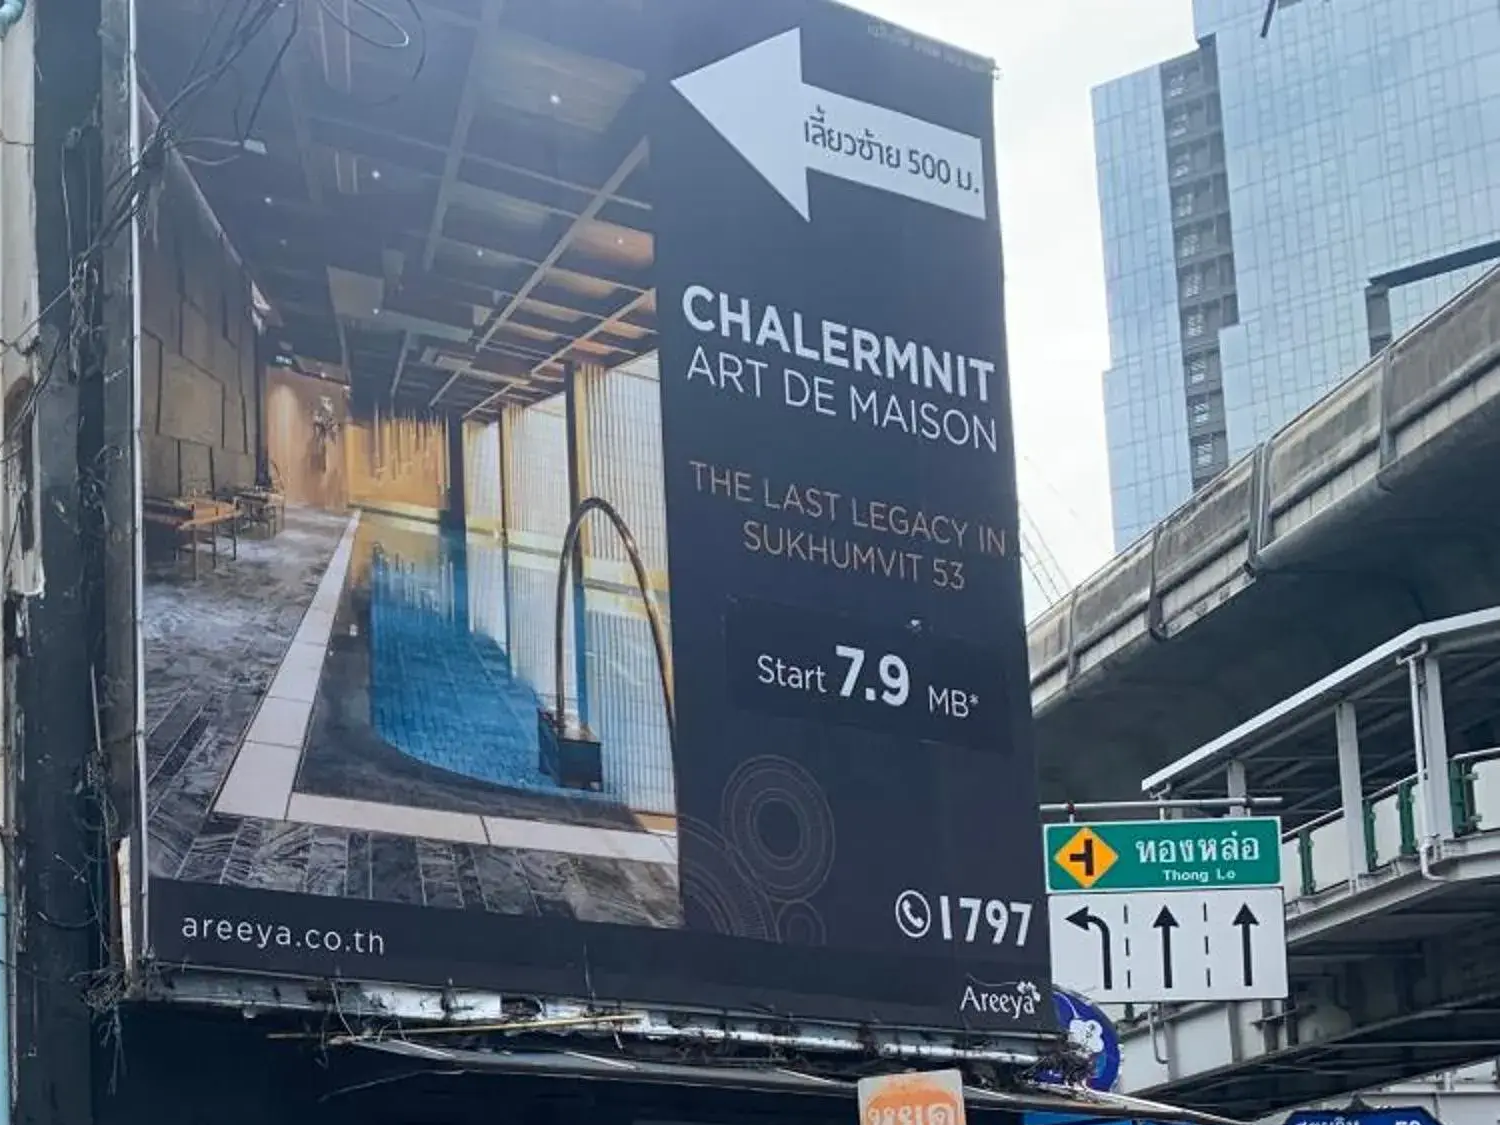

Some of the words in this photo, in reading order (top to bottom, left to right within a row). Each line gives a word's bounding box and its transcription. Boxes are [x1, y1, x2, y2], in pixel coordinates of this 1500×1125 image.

[804, 103, 901, 169] เลี้ยวซ้าย
[908, 149, 950, 184] 500
[682, 285, 995, 402] CHALERMNIT
[687, 345, 768, 398] ART
[784, 368, 837, 416] DE
[850, 384, 997, 452] MAISON
[689, 460, 753, 502] THE
[763, 478, 841, 521] LAST
[851, 497, 968, 548] LEGACY
[978, 525, 1006, 557] IN
[743, 520, 923, 582] SUKHUMVIT
[932, 558, 965, 590] 53
[757, 654, 828, 693] Start
[835, 645, 910, 707] 7.9
[1135, 829, 1260, 864] ทองหล่อ
[1163, 868, 1209, 882] Thong
[1217, 868, 1236, 880] Lo
[181, 916, 385, 956] areeya.co.th
[939, 895, 1032, 947] 1797
[959, 985, 1036, 1020] Areeya
